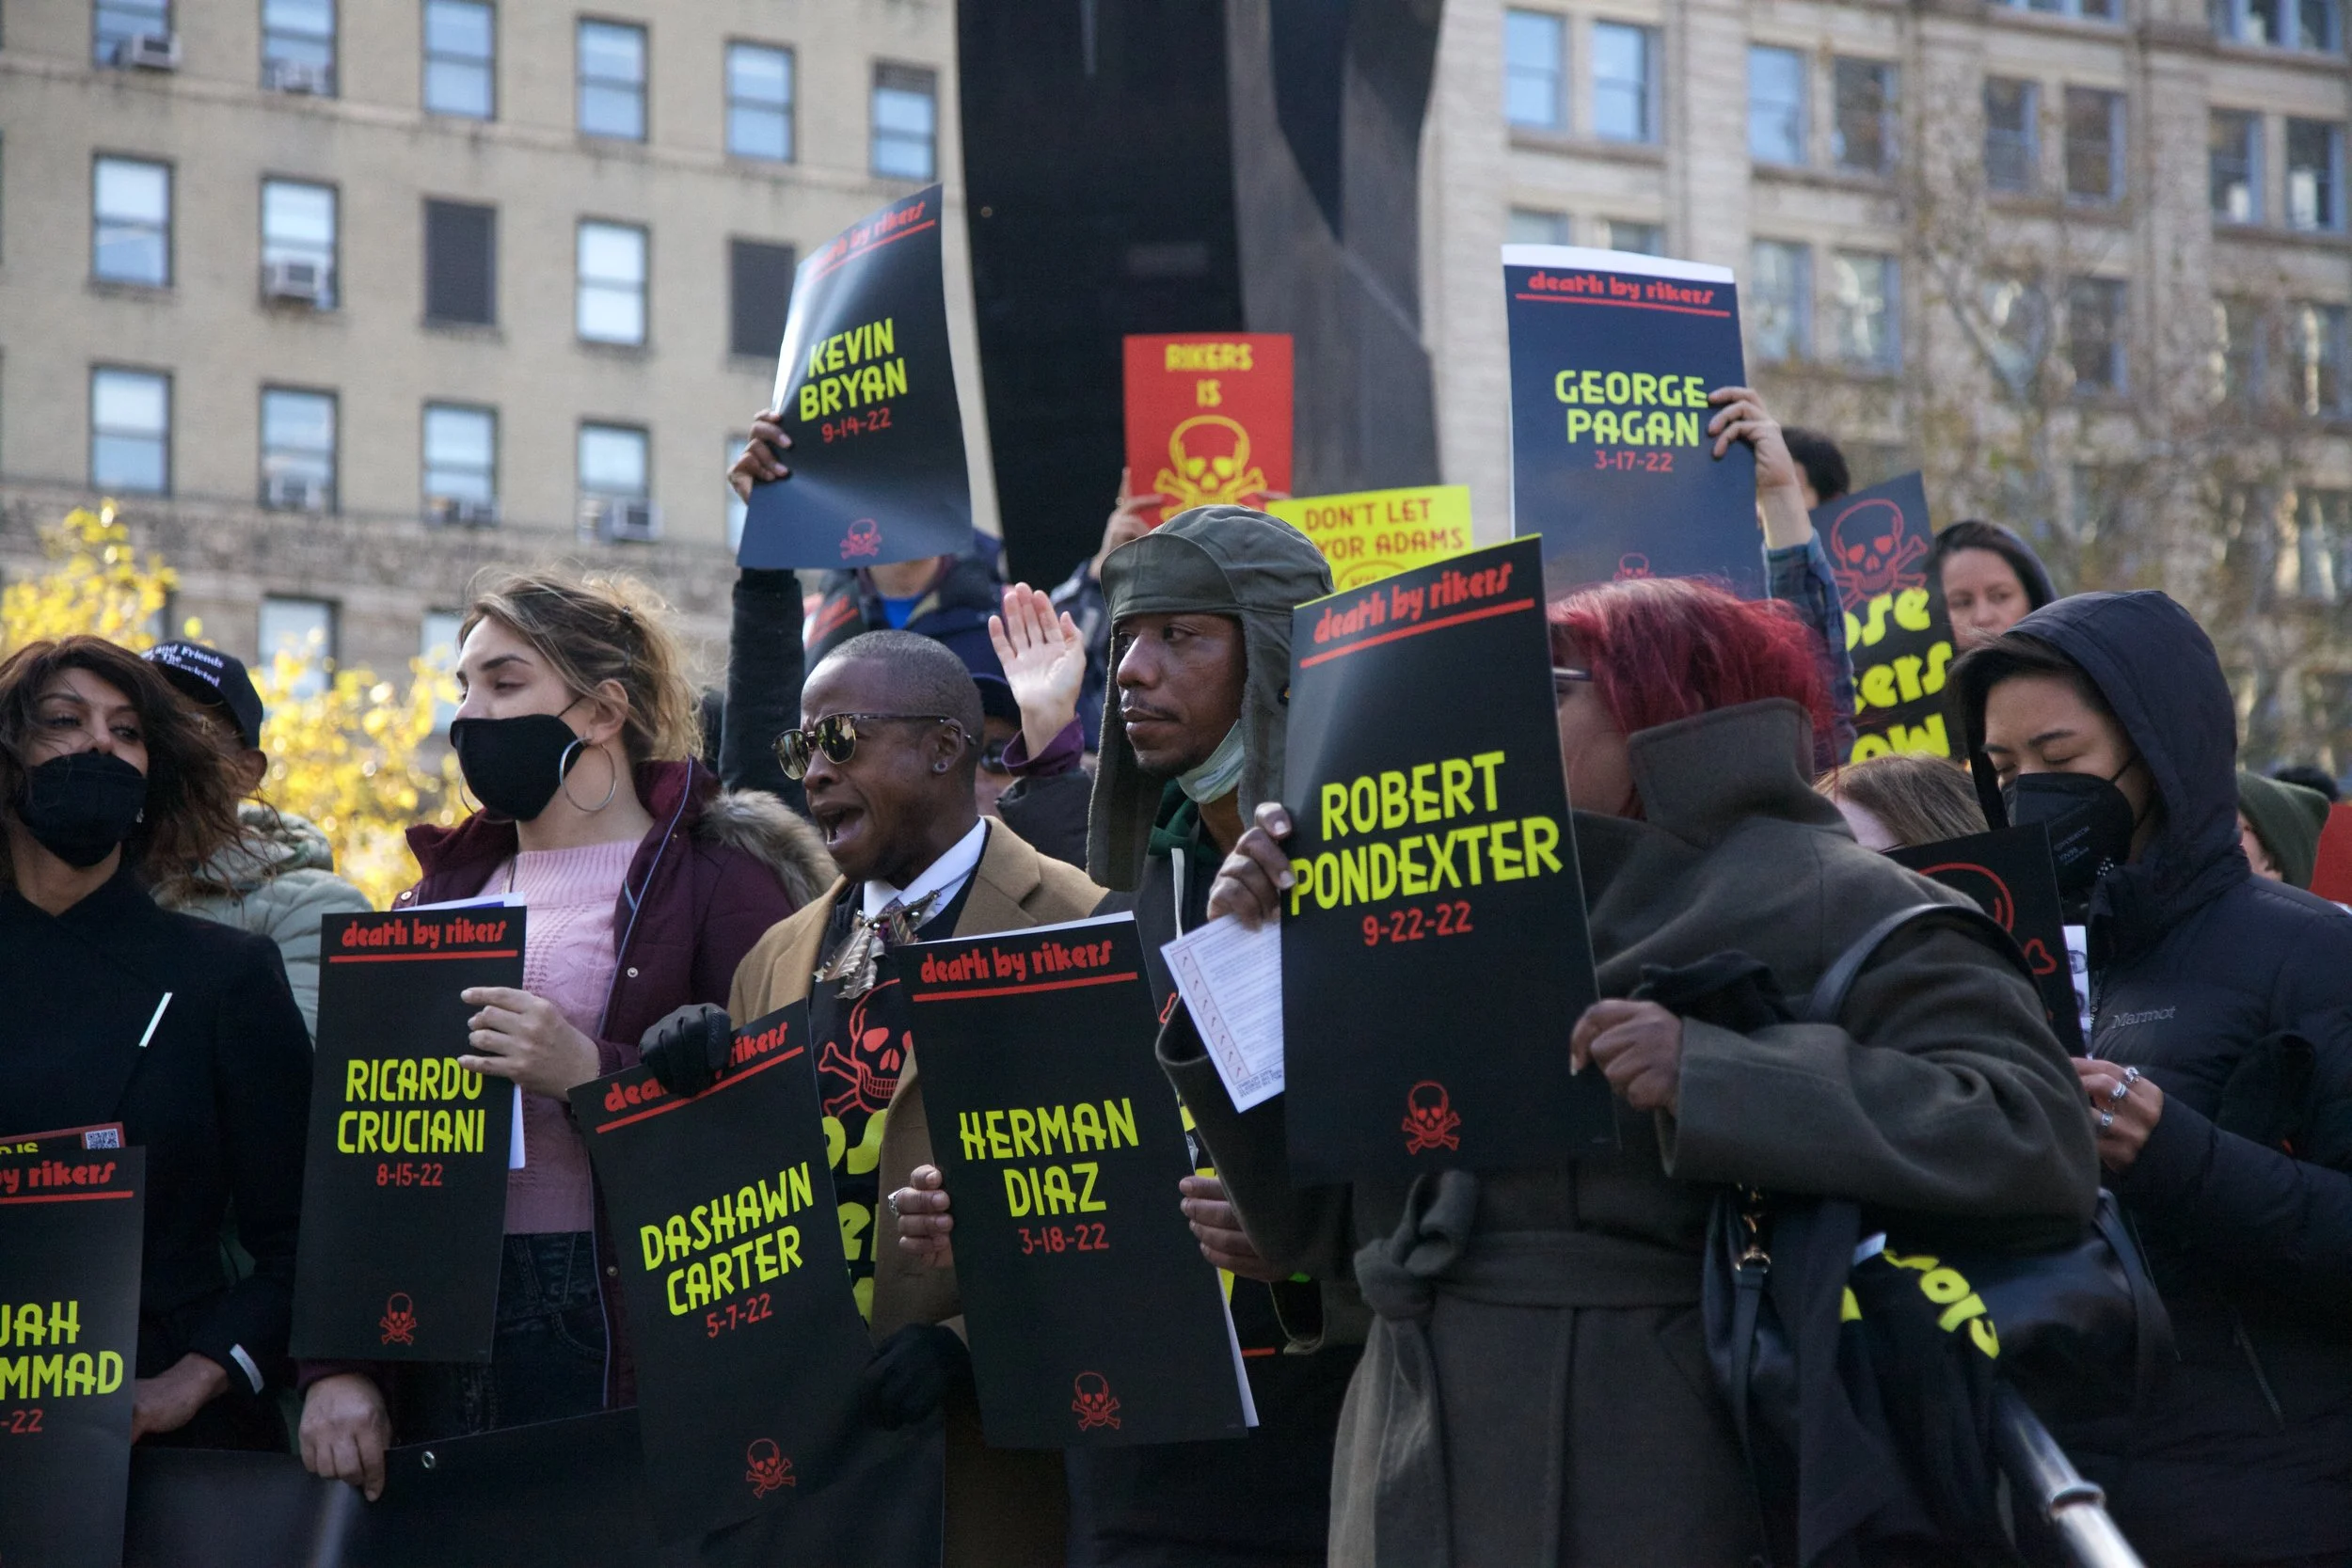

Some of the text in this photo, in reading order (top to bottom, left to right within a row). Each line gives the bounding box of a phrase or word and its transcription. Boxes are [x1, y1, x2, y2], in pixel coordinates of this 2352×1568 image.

[1529, 272, 1714, 305] death by rikers
[808, 318, 895, 378] KEVIN
[1166, 342, 1253, 372] RIKERS
[800, 357, 908, 421] BRYAN
[1197, 379, 1222, 407] IS
[1555, 371, 1708, 408] GEORGE
[821, 406, 893, 443] 9-14-22
[1566, 409, 1700, 447] PAGAN
[1595, 451, 1674, 472] 3-17-22
[1305, 499, 1432, 531] DON'T LET
[1317, 528, 1465, 560] YOR ADAMS
[1313, 562, 1514, 643] death by rikers
[182, 645, 224, 669] Friends
[1322, 751, 1505, 841] ROBERT
[1290, 816, 1564, 916] PONDEXTER
[342, 917, 507, 949] death by rikers
[1362, 900, 1473, 946] 9-22-22
[921, 940, 1113, 984] death by rikers
[2111, 1006, 2176, 1029] Marmot
[345, 1056, 483, 1102] RICARDO
[604, 1077, 669, 1112] dea
[337, 1109, 485, 1154] CRUCIANI
[960, 1098, 1139, 1161] HERMAN
[28, 1160, 117, 1187] rikers
[376, 1163, 443, 1186] 8-15-22
[1003, 1162, 1107, 1217] DIAZ
[640, 1162, 814, 1271] DASHAWN
[1018, 1222, 1109, 1255] 3-18-22
[666, 1226, 803, 1316] CARTER
[706, 1292, 772, 1338] 5-7-22
